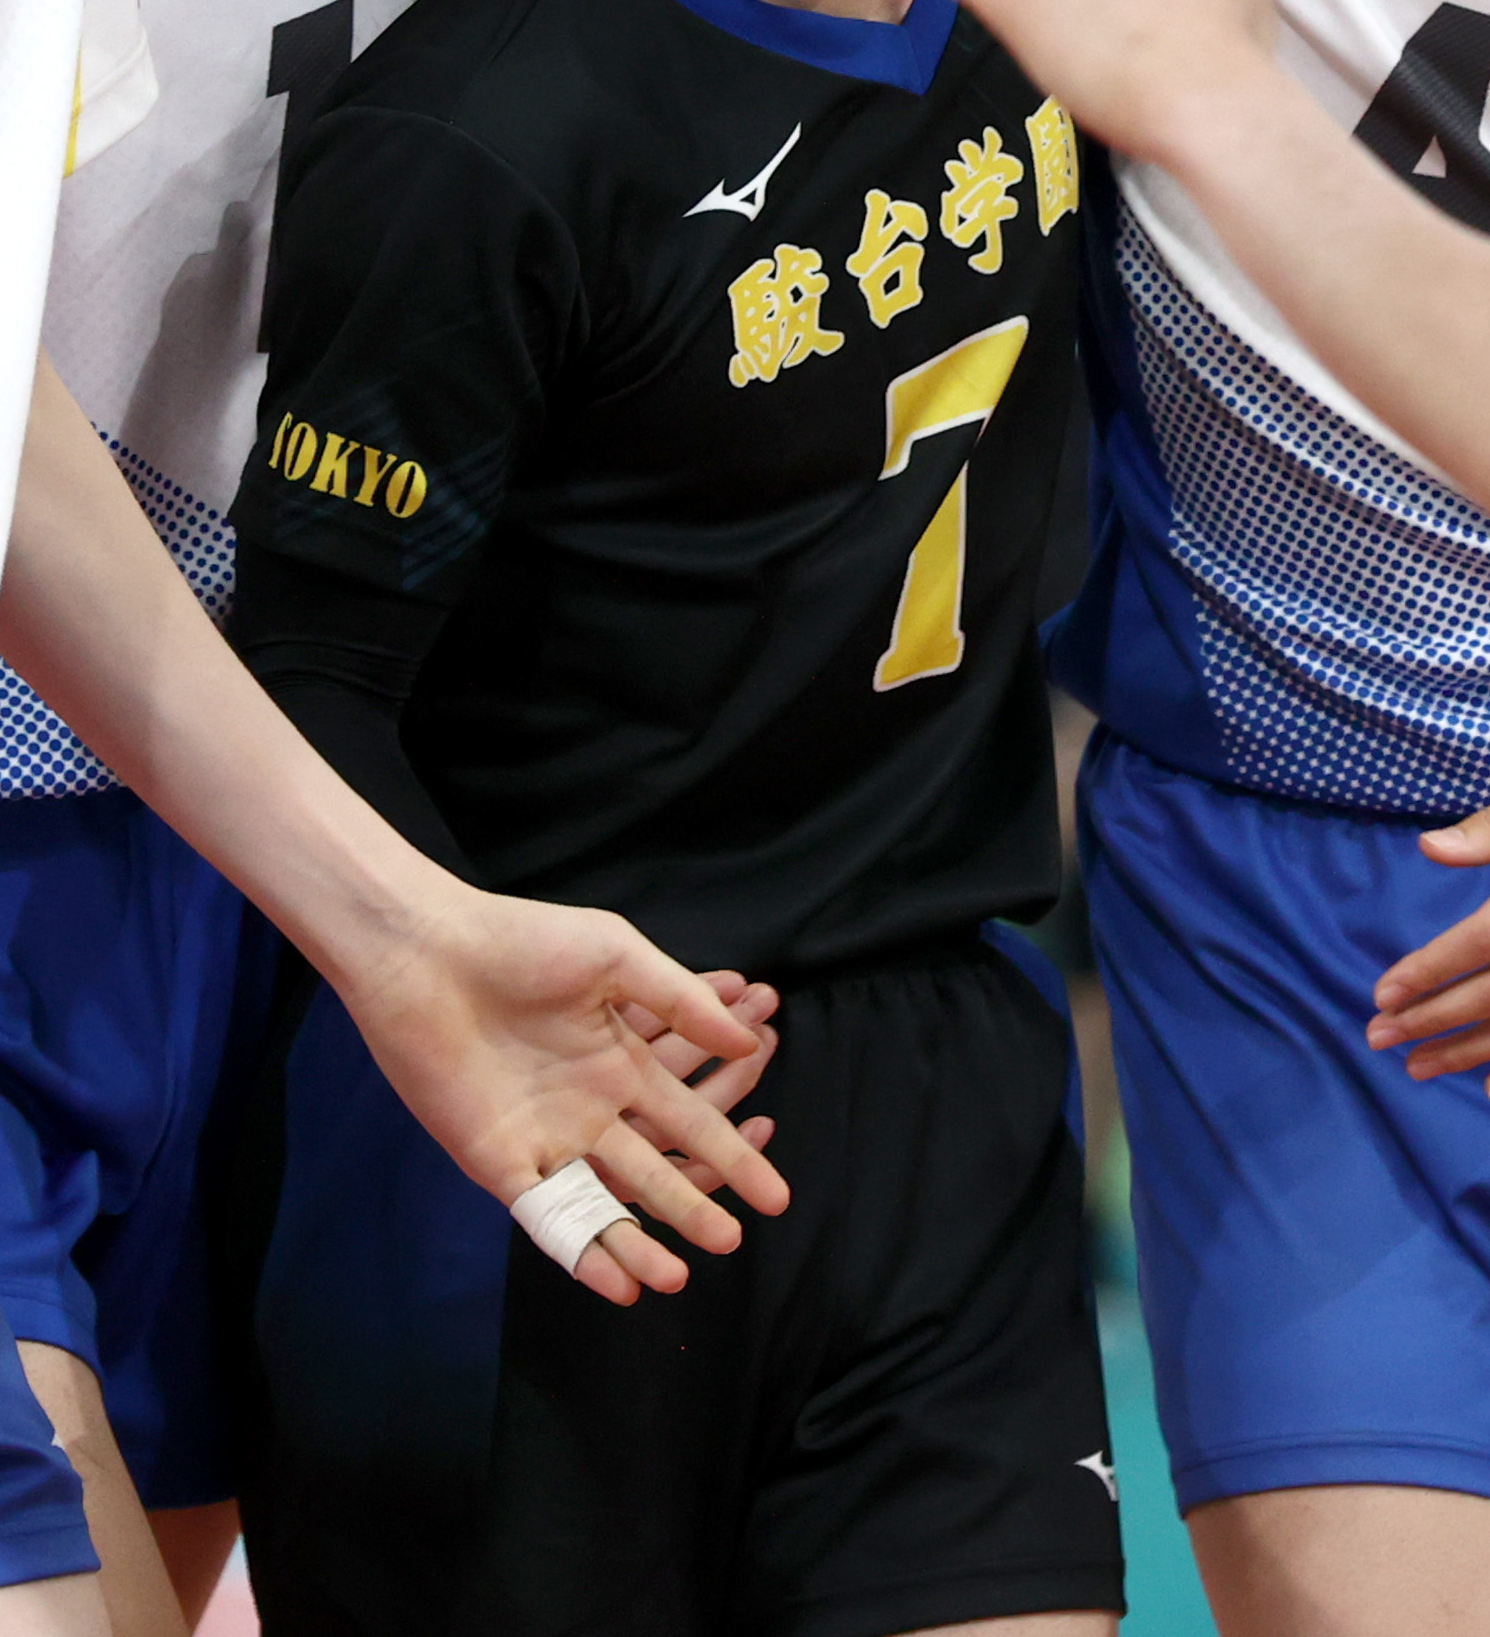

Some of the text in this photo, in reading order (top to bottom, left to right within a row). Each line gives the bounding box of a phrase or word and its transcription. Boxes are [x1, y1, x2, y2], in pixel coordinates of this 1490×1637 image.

[728, 94, 1079, 388] 駿台学園
[873, 315, 1029, 693] 7
